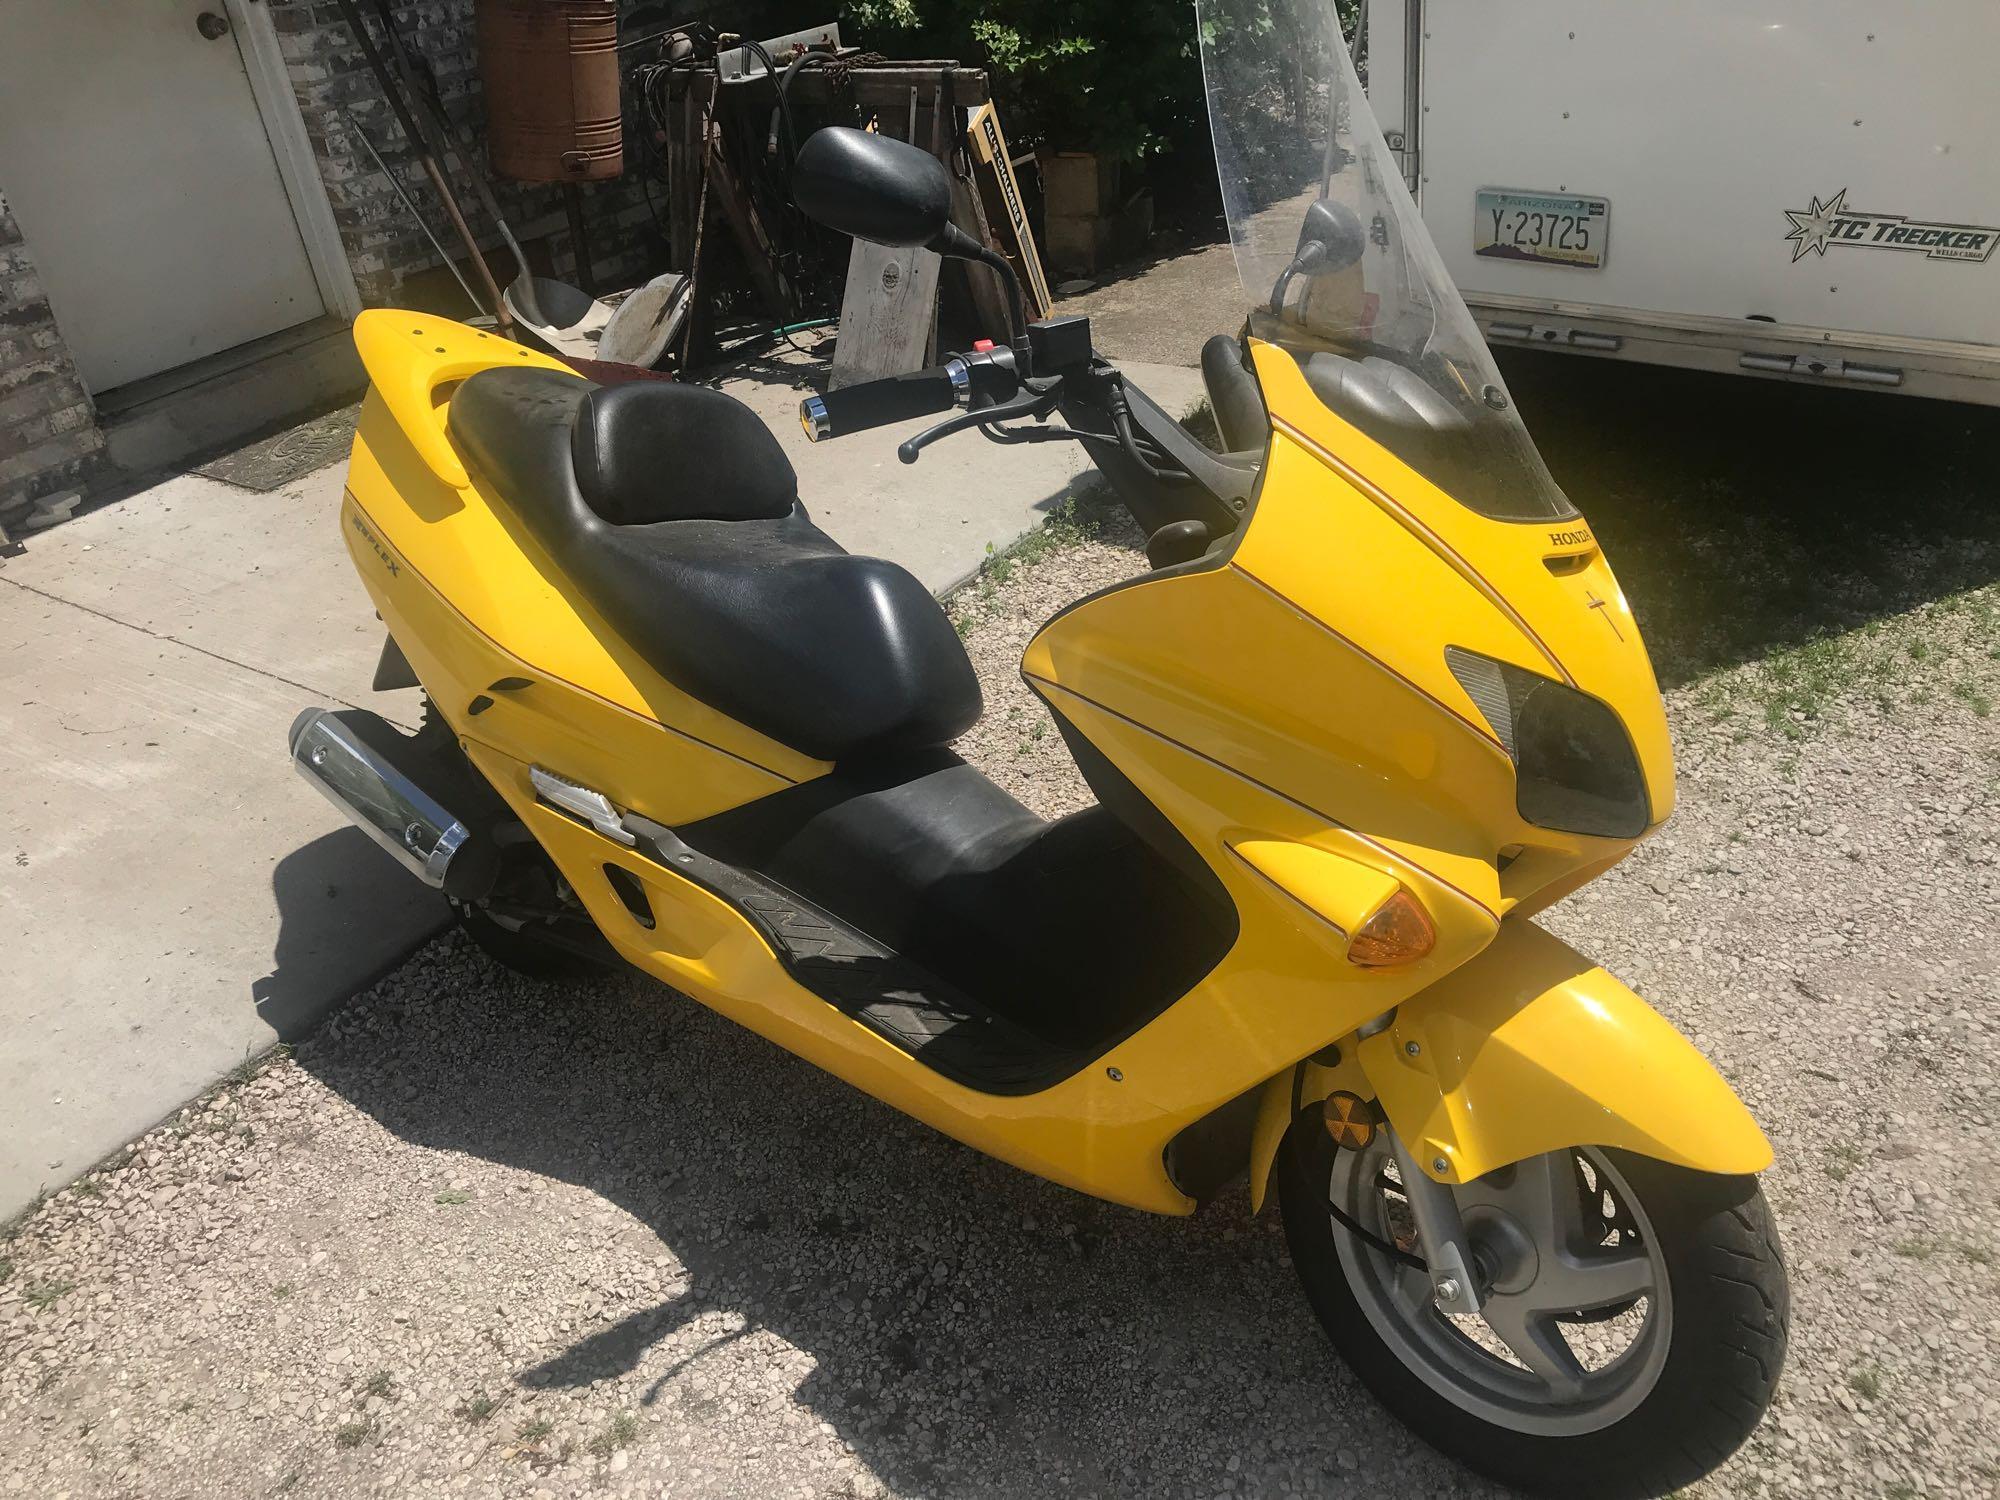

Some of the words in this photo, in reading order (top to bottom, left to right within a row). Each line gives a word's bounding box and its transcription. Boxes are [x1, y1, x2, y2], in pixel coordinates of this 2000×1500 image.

[1828, 218, 1871, 240] TC
[1872, 223, 1989, 250] TRECKER
[1548, 529, 1592, 546] HONDA
